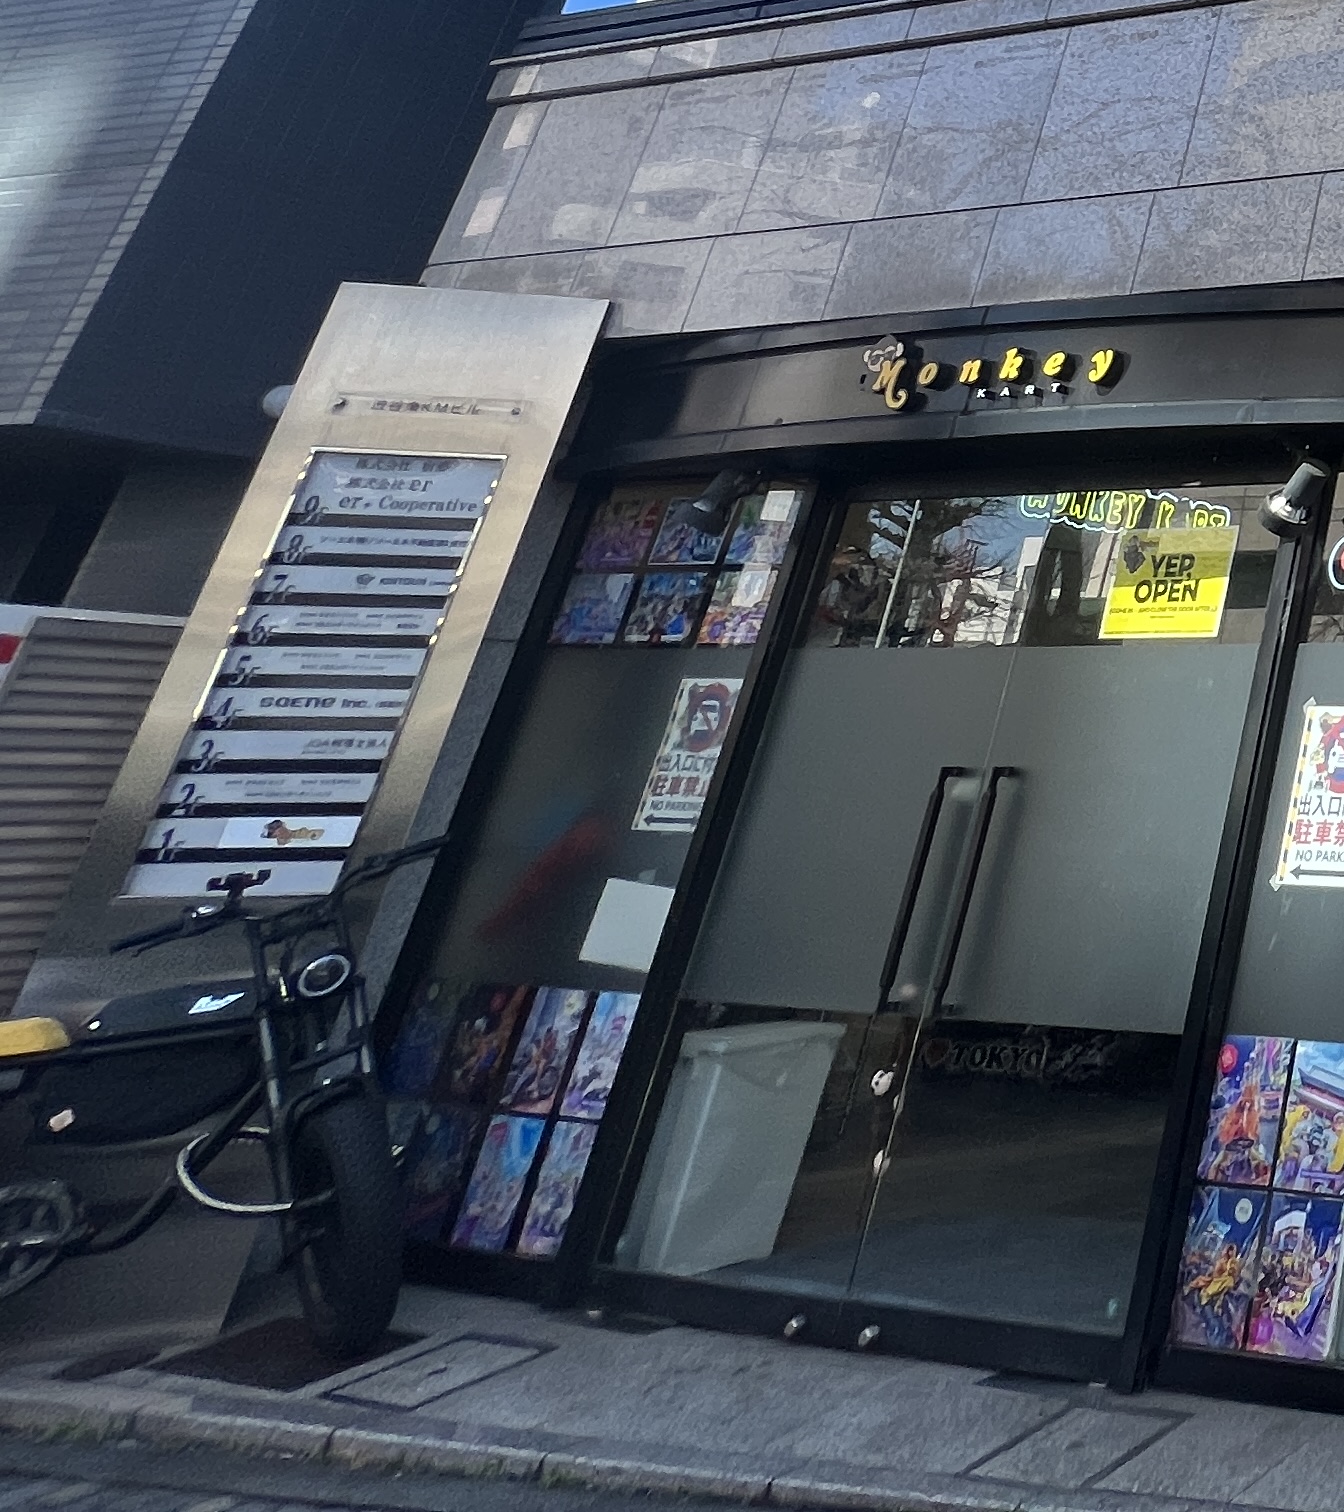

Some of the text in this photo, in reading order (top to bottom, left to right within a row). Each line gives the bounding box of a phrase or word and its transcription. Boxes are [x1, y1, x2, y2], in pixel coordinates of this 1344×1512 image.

[871, 348, 1115, 410] Monkey
[976, 381, 1062, 399] KART
[378, 494, 478, 513] Cooperative
[1134, 578, 1199, 604] OPEN
[1295, 849, 1314, 863] NO
